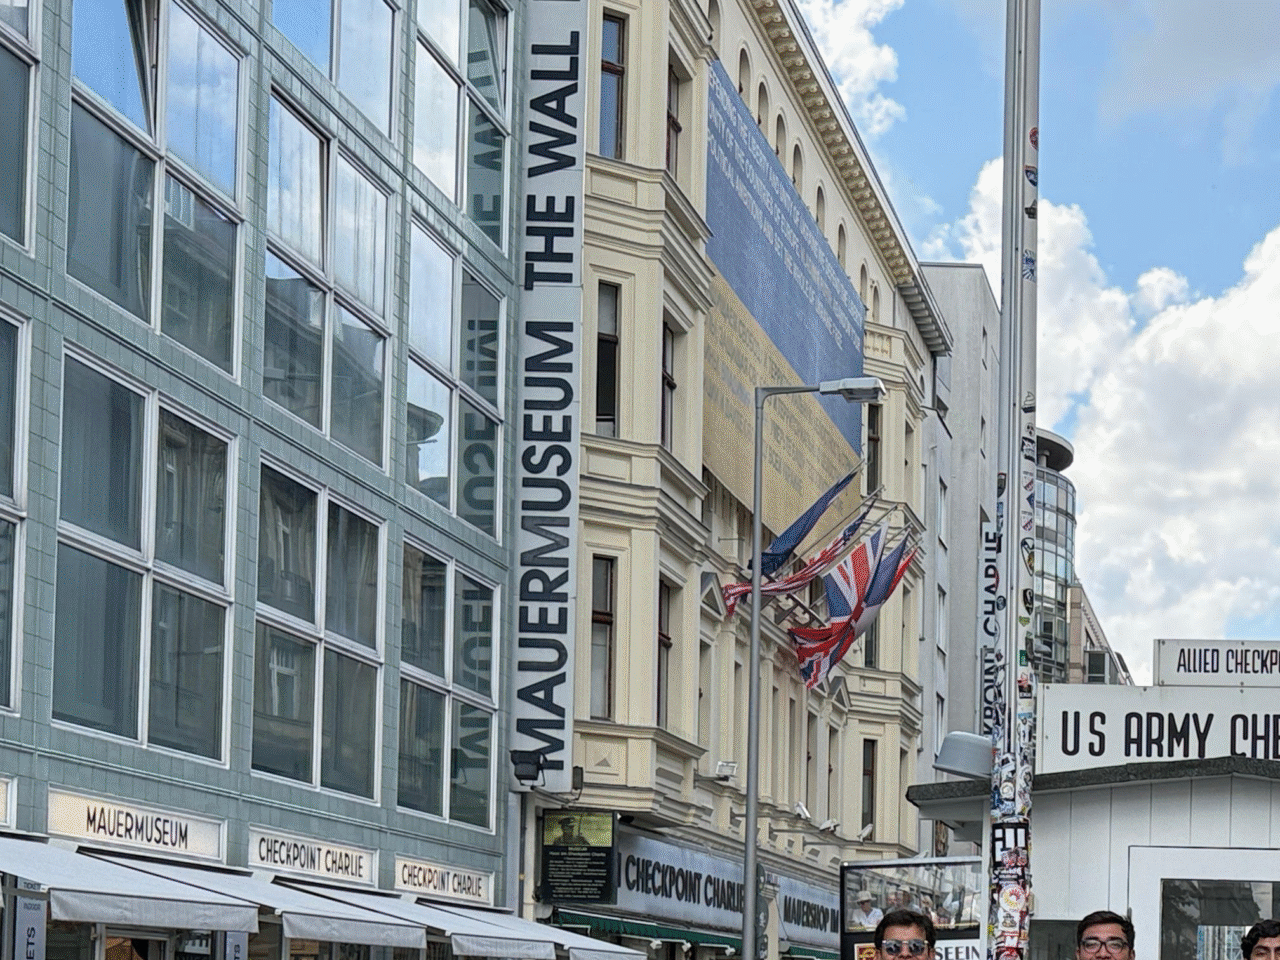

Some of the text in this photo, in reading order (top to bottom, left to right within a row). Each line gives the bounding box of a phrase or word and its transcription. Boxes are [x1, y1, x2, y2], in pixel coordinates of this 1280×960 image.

[524, 31, 580, 291] THE WALL
[516, 321, 573, 771] MAUERMUSEUM
[1177, 648, 1219, 673] ALLIED
[1124, 711, 1214, 759] ARMY
[86, 805, 189, 850] MAUERMUSEUM
[258, 836, 364, 878] CHECKPOINT CHARLIE
[625, 854, 703, 903] CHECKPOINT
[402, 863, 482, 897] CHECKPOINT CHARLIE
[783, 895, 830, 932] MAUERSHOP
